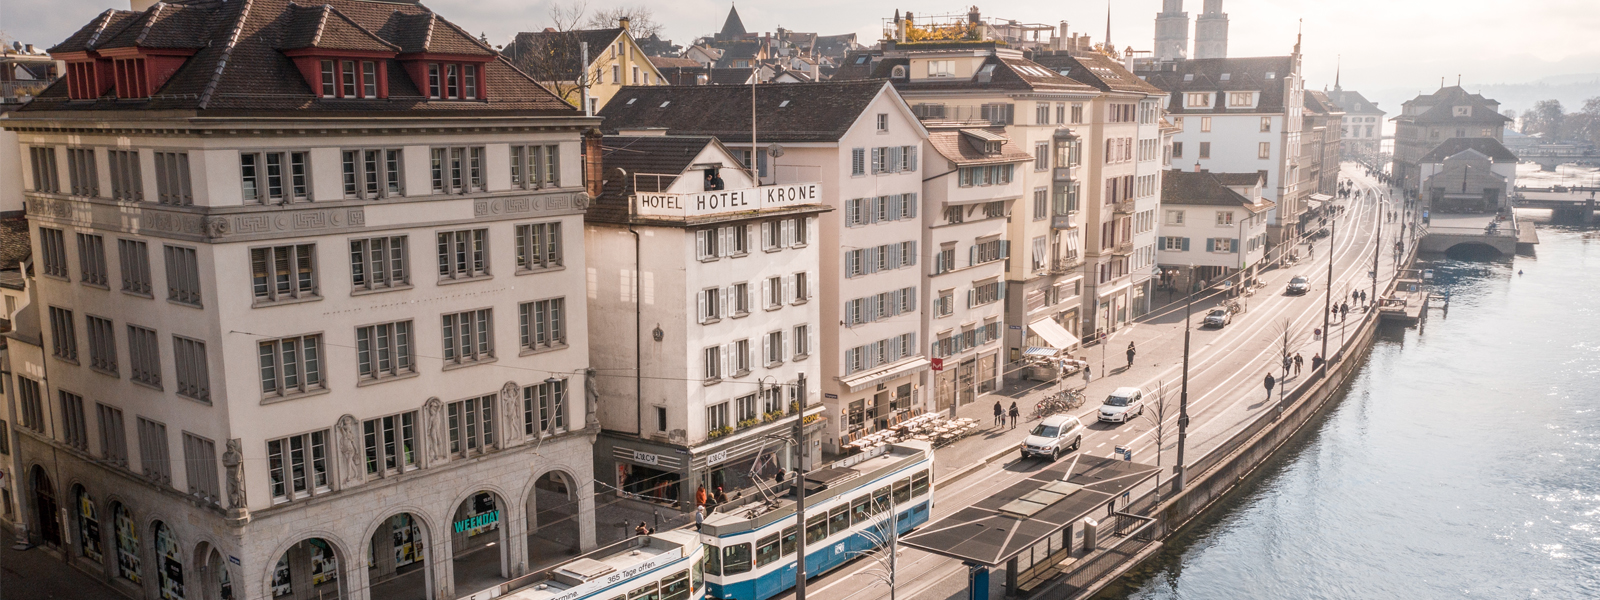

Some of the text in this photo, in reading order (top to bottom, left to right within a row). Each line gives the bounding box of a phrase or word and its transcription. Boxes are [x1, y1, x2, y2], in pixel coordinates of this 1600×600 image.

[642, 195, 682, 209] HOTEL
[697, 185, 816, 210] HOTEL KRONE
[454, 510, 500, 533] WEEKDAY
[607, 575, 621, 584] 365
[622, 569, 637, 578] Tage
[638, 561, 656, 572] offen.
